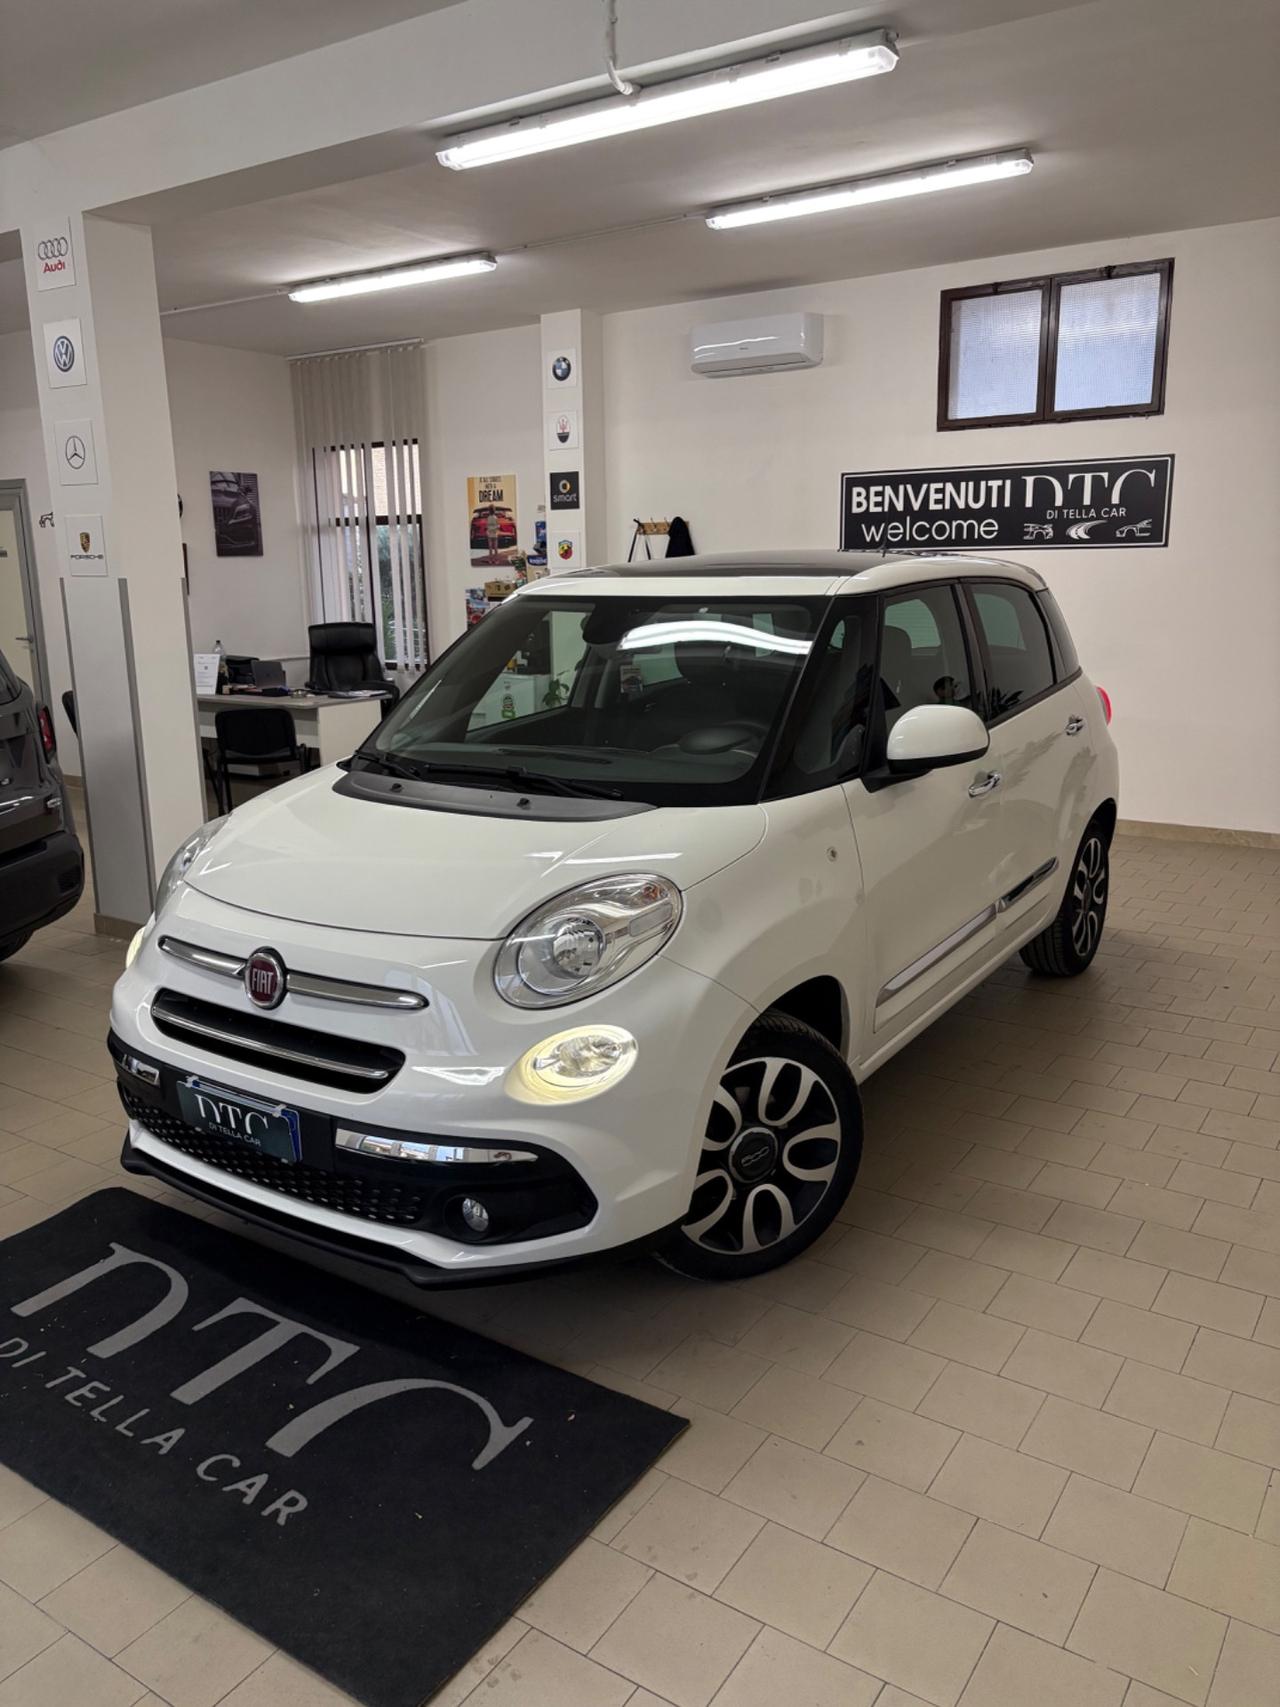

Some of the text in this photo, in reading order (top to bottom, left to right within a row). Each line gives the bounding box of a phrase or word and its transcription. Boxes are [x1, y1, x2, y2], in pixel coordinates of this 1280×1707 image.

[43, 259, 66, 273] Audi
[478, 489, 504, 503] DREAM
[552, 493, 577, 504] smart
[851, 468, 1156, 514] BENVENUTI DTC
[1046, 507, 1127, 519] DI TELLA CAR
[861, 515, 999, 542] welcome
[251, 967, 274, 995] FIAT
[208, 1121, 262, 1147] DI TELLA CAR
[45, 1366, 186, 1455] TELLA
[196, 1453, 308, 1526] CAR
